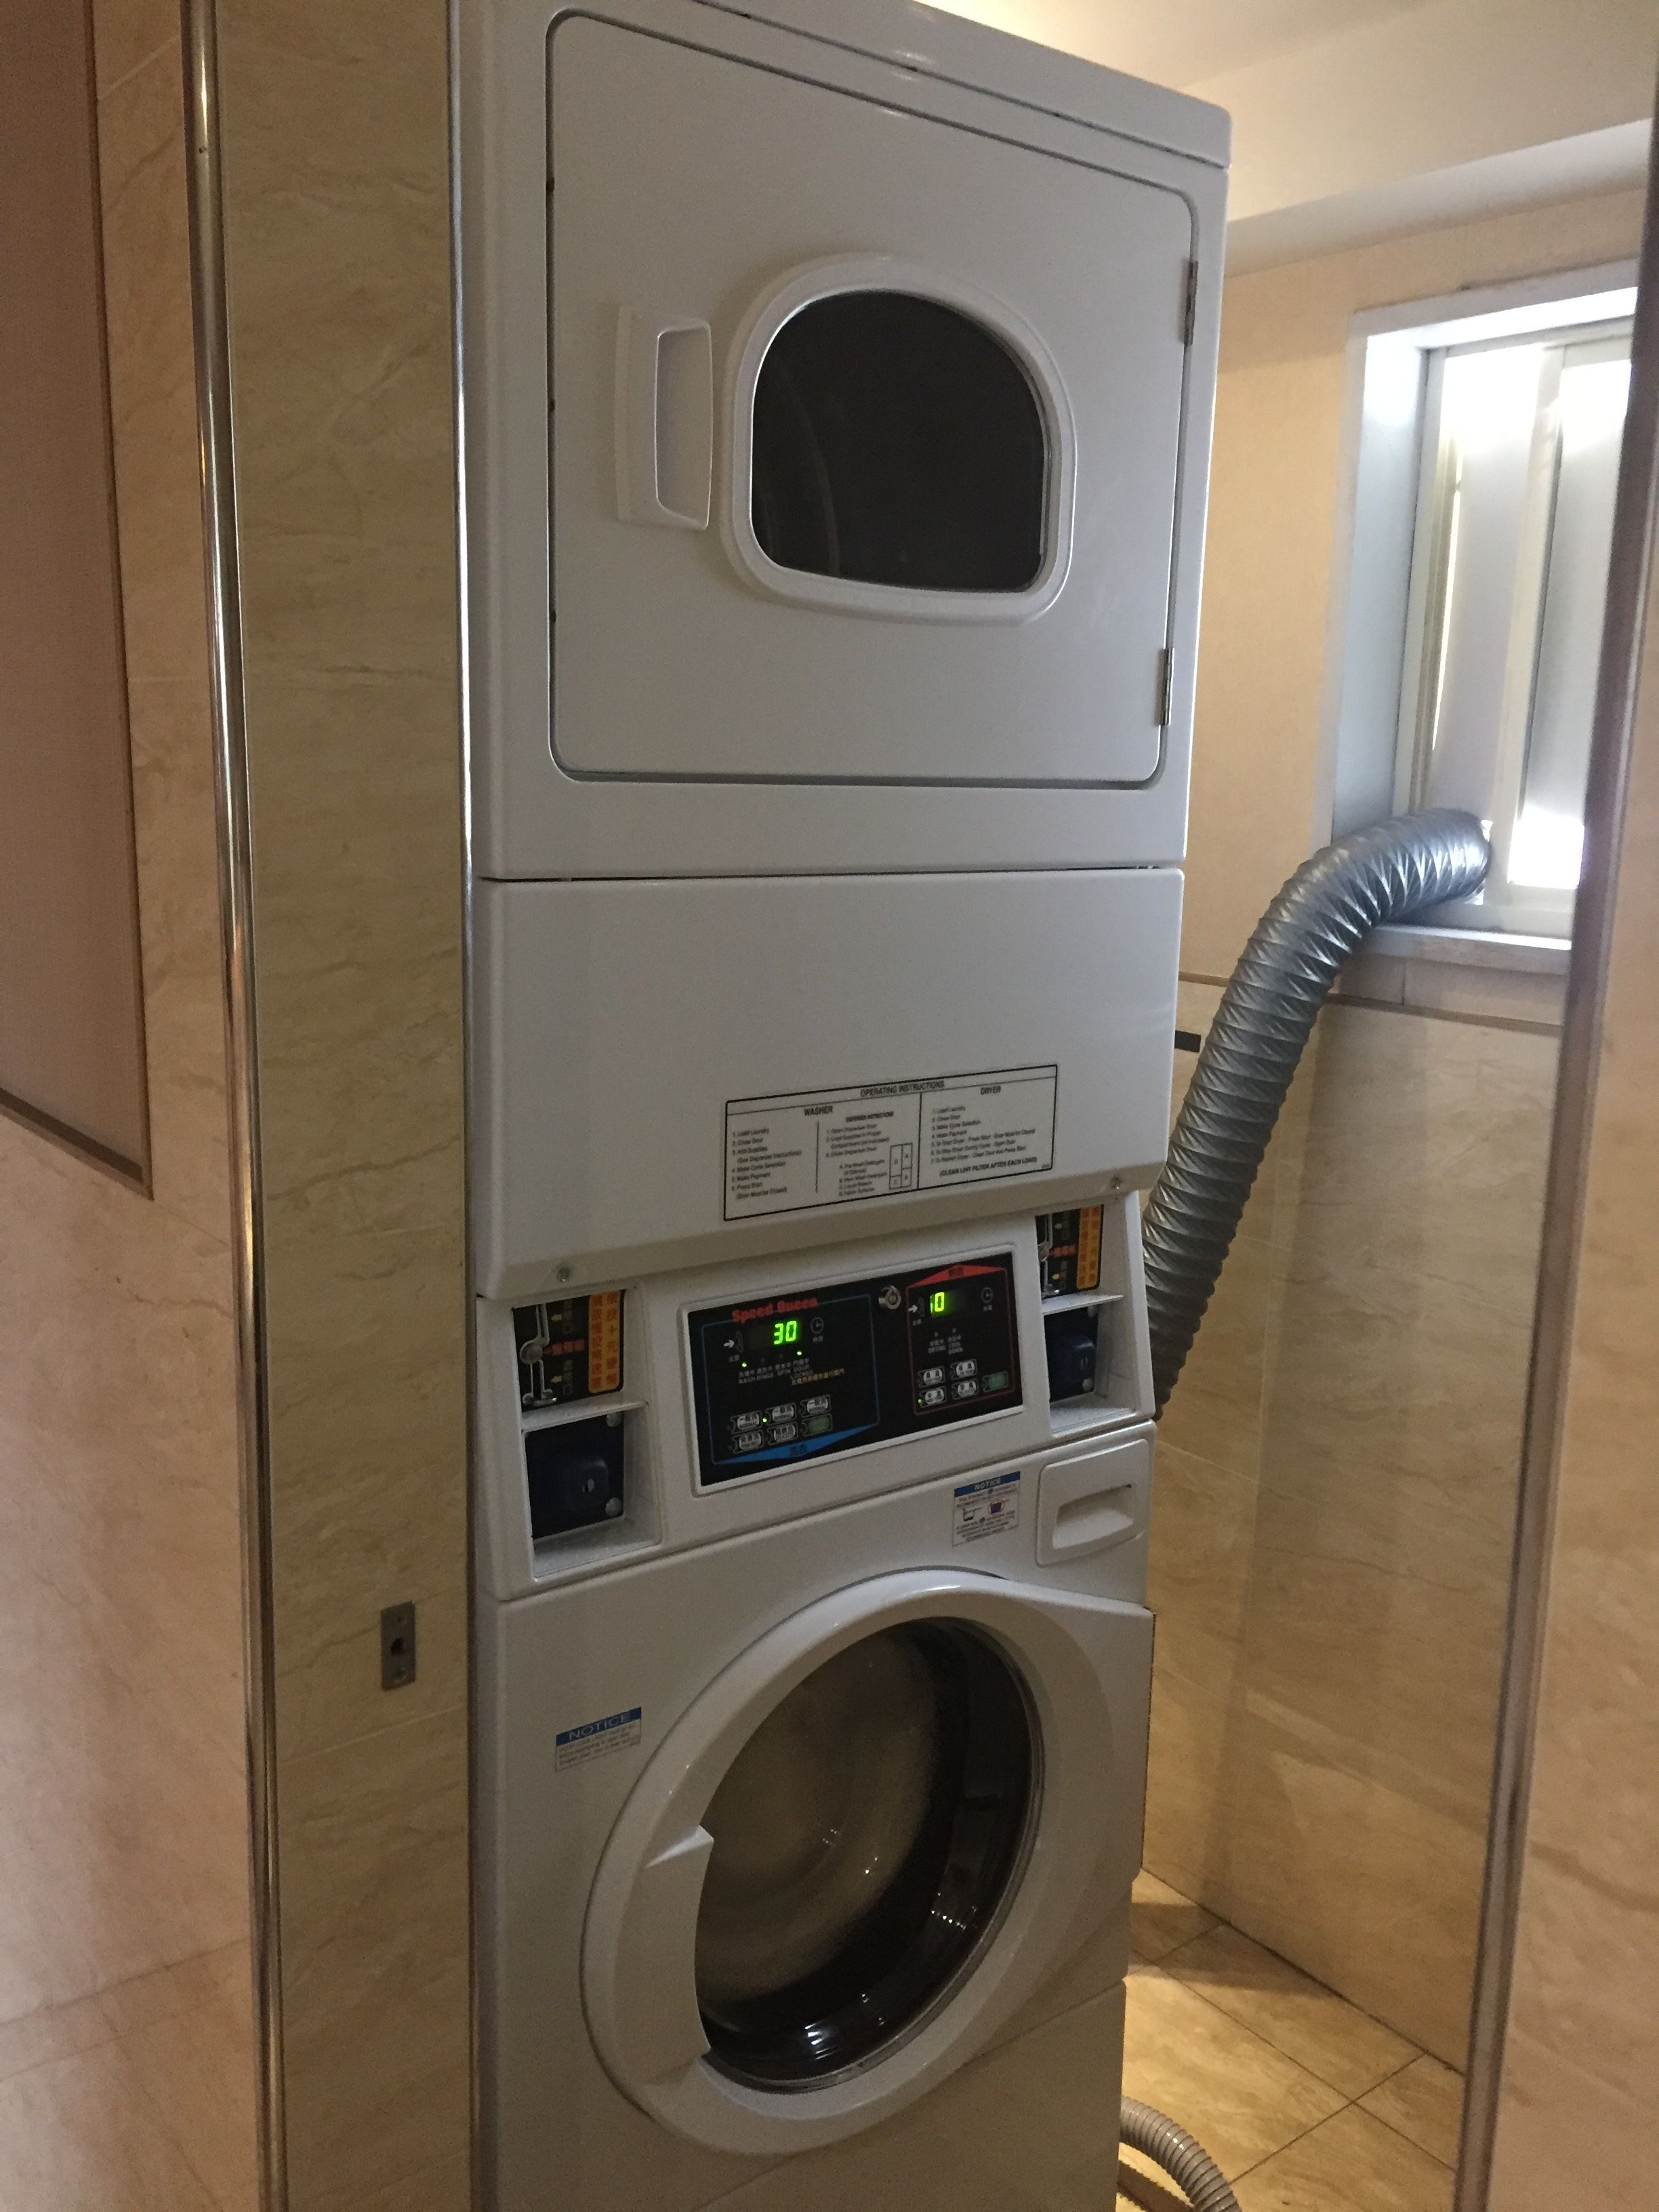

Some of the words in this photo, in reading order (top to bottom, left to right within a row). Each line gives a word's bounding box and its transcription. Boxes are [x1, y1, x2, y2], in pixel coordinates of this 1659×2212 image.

[861, 1087, 897, 1096] OPERATING
[899, 1081, 945, 1092] INSTRUCTIONS
[980, 1086, 1001, 1095] DRYER
[804, 1105, 833, 1116] WASHER
[732, 1303, 773, 1323] Speed
[777, 1298, 818, 1313] Queen
[774, 1320, 797, 1345] 30
[975, 1478, 1002, 1490] NOTICE
[569, 1713, 630, 1740] NOTICE
